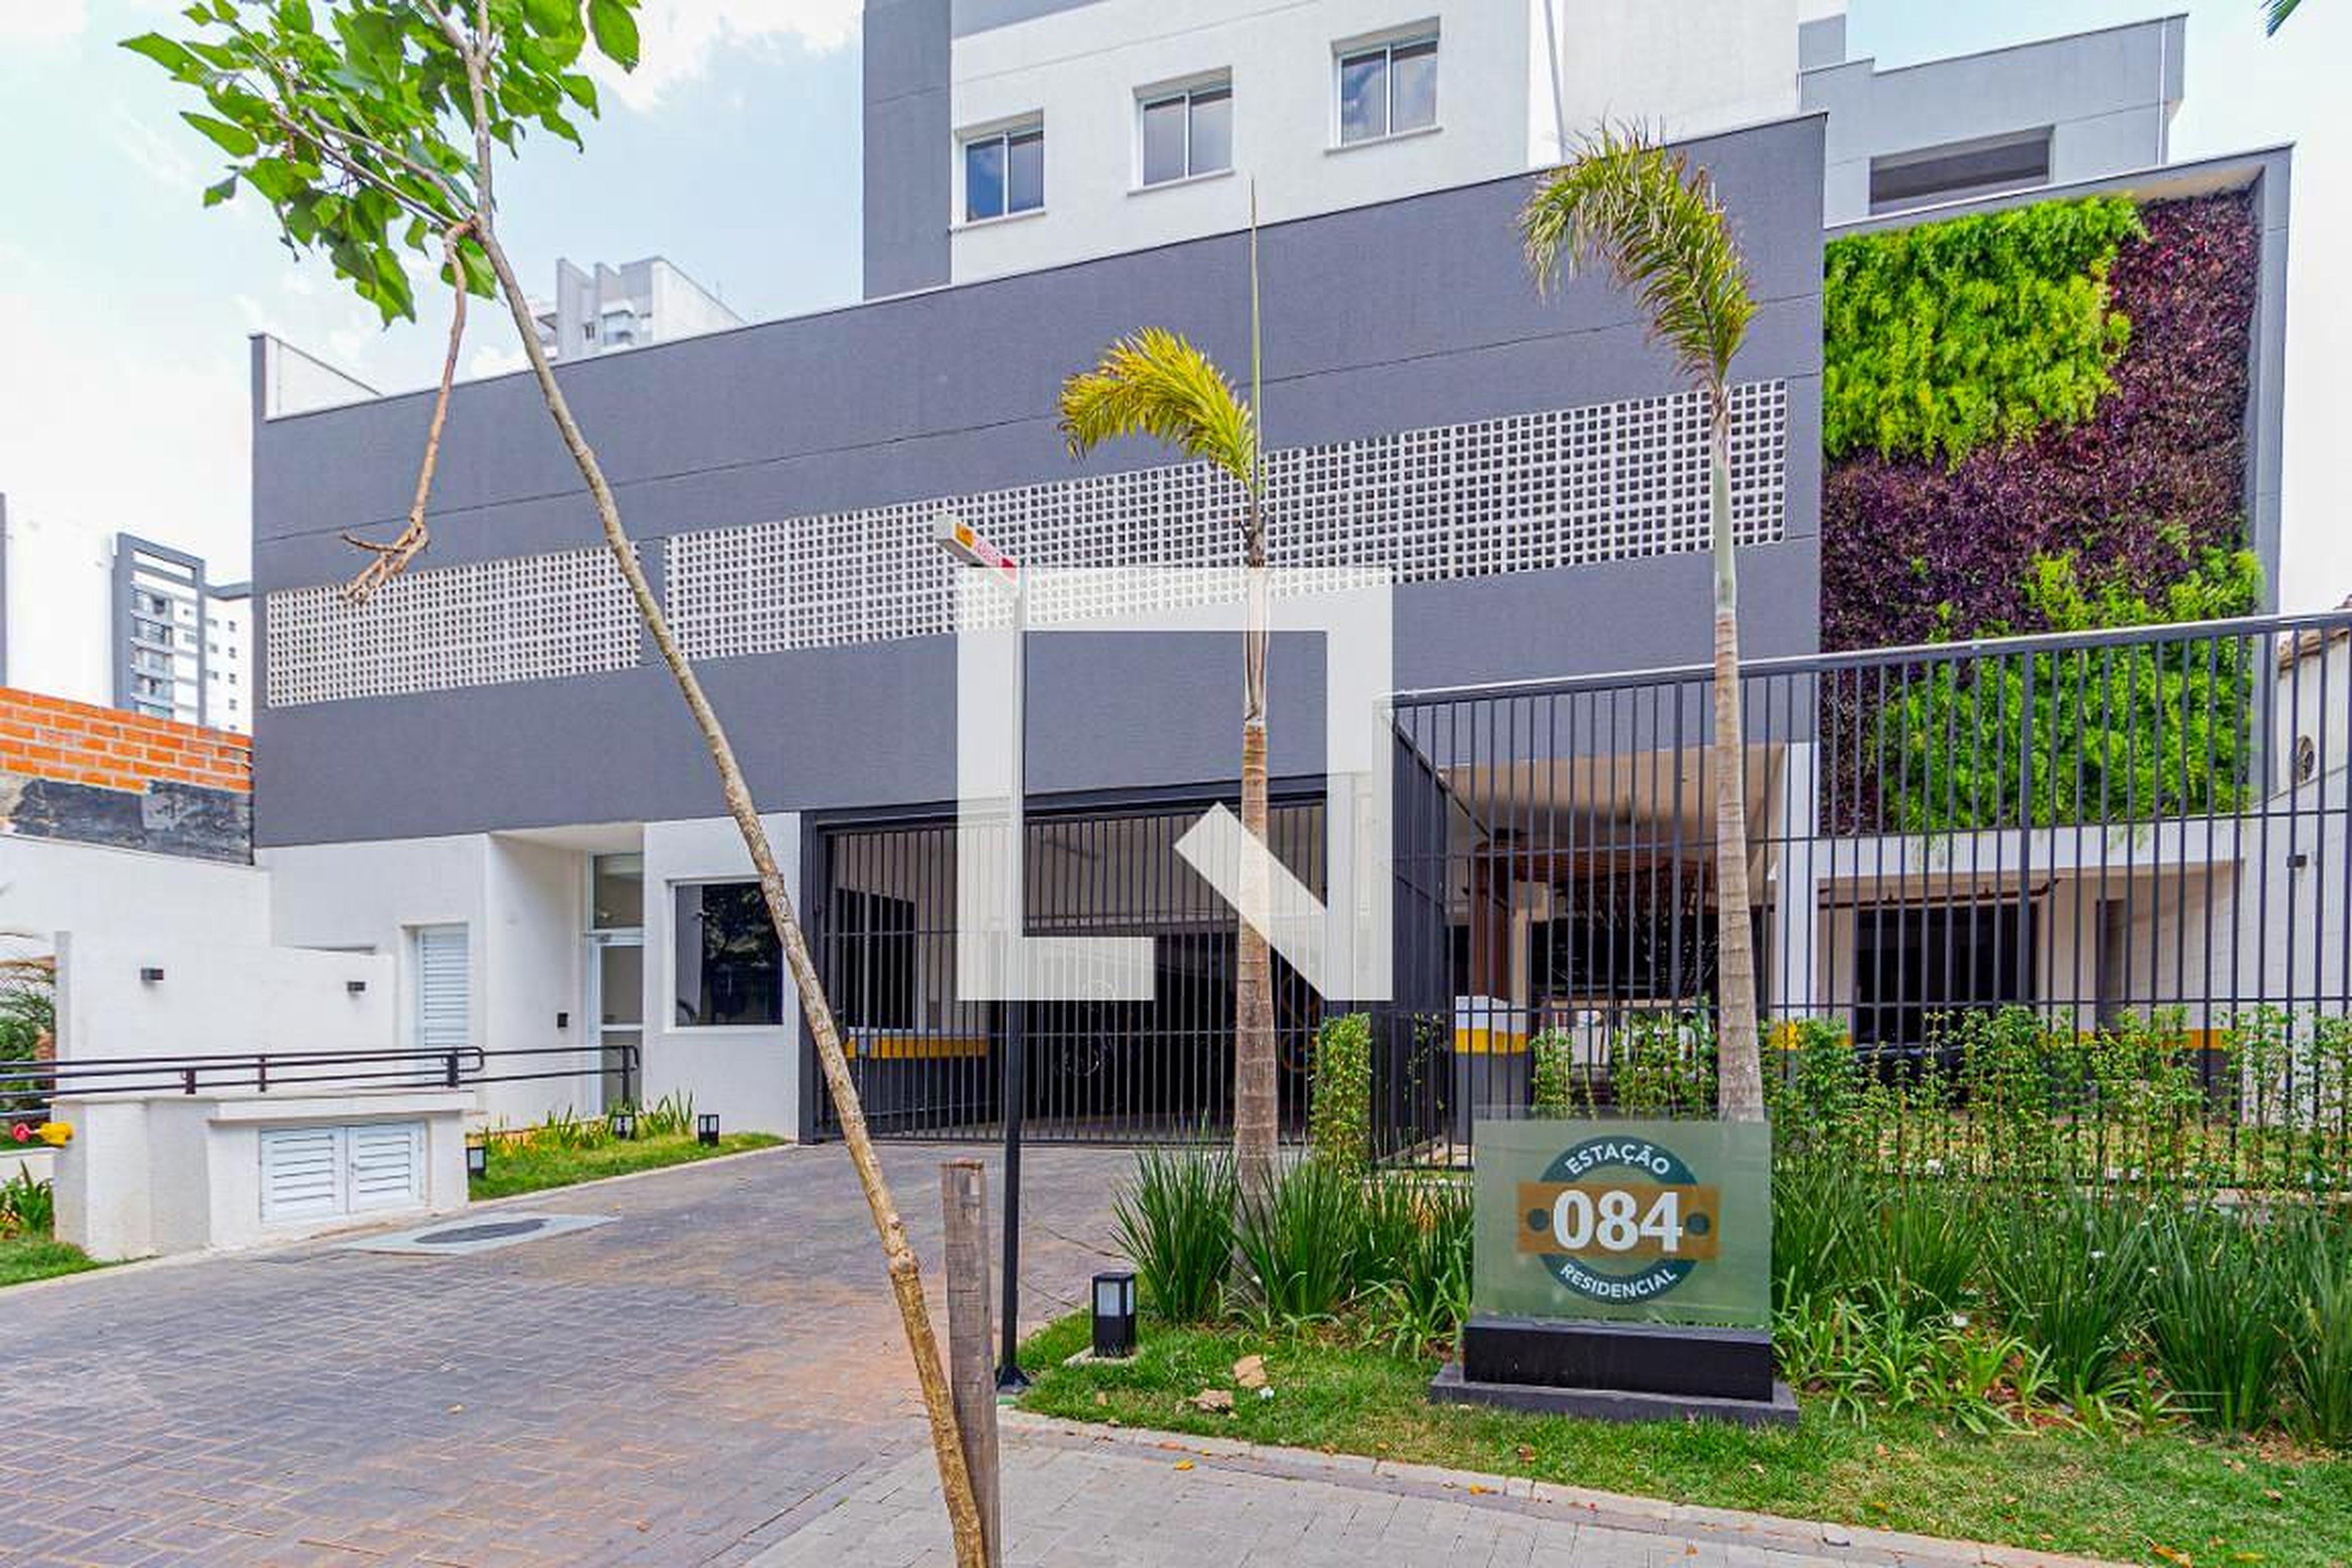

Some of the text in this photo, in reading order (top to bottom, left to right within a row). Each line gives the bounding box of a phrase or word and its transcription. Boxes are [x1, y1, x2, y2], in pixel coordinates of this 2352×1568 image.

[1566, 1144, 1670, 1175] ESTAÇÃO
[1553, 1189, 1683, 1252] 084
[1561, 1263, 1677, 1298] RESIDENCIAL
